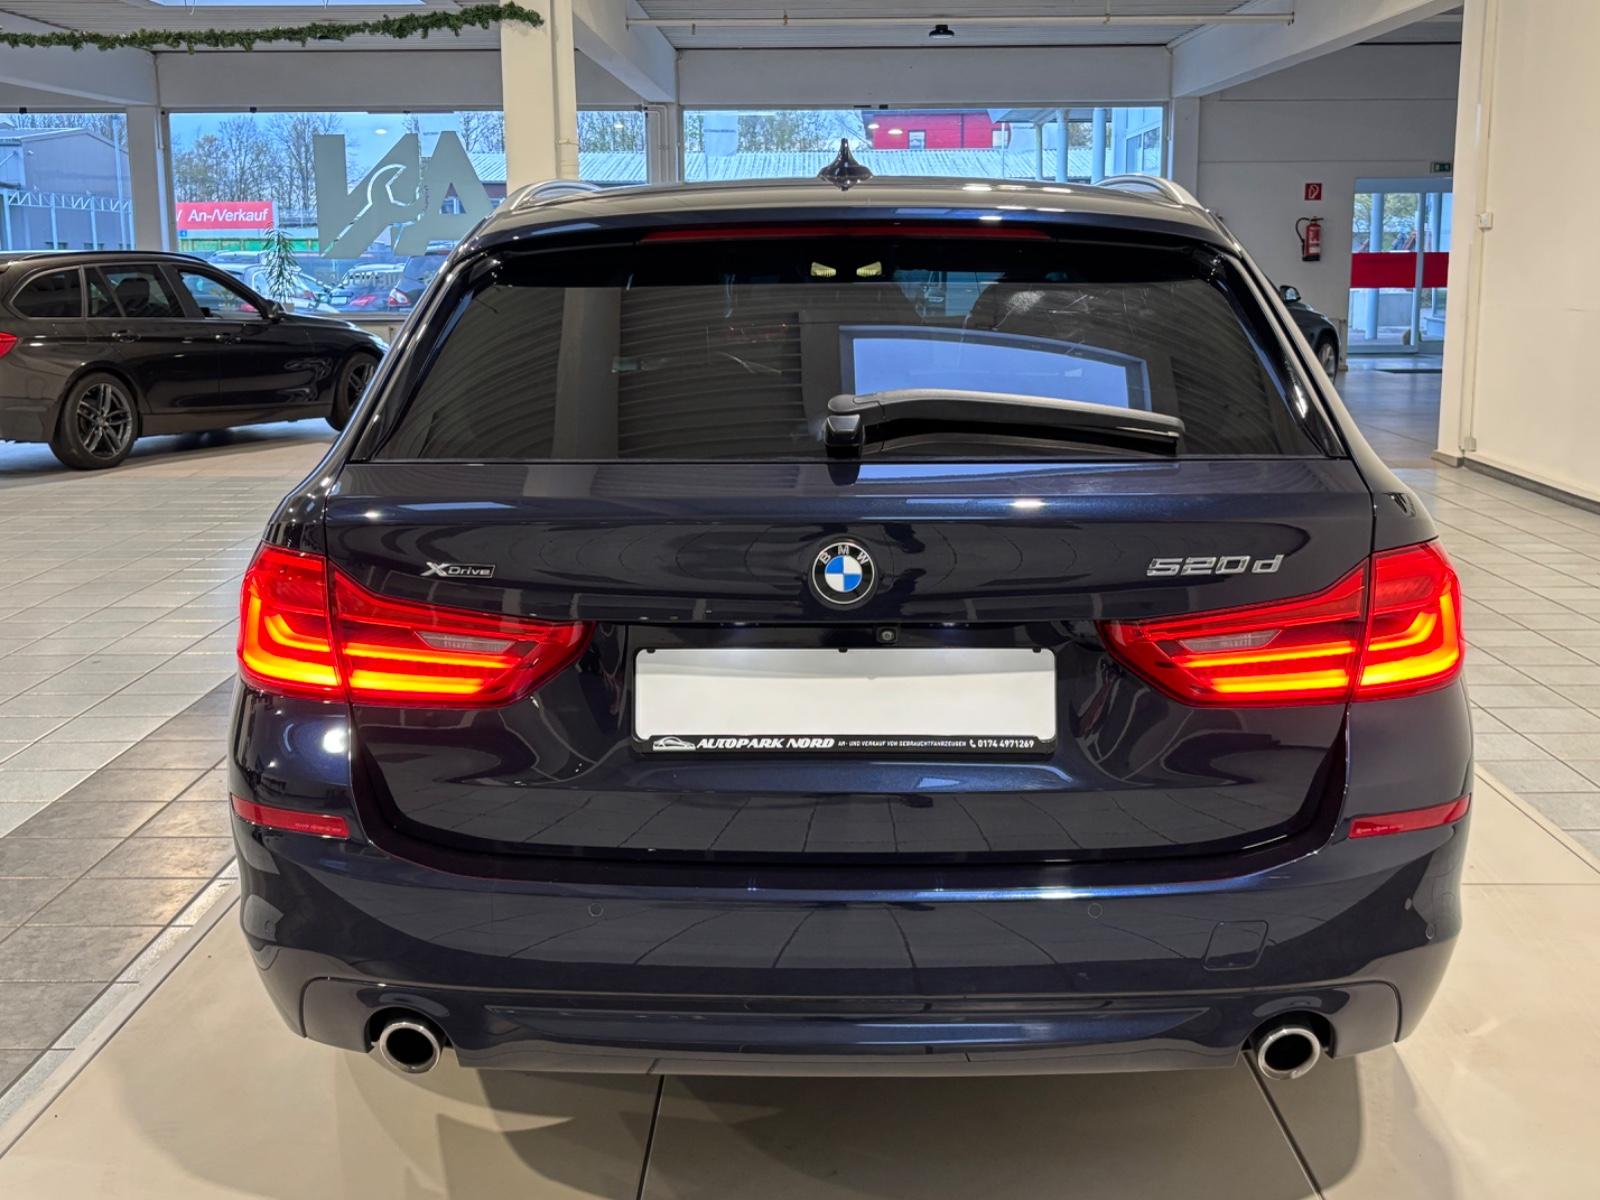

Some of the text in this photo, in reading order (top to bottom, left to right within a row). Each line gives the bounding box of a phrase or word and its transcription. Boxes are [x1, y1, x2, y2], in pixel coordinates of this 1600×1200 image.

[188, 208, 269, 222] An-/Verkauf
[819, 544, 870, 565] BMW
[1147, 554, 1284, 576] 520d
[697, 738, 835, 749] AUTOPARK NORD
[978, 739, 1035, 748] 0174 4971269
